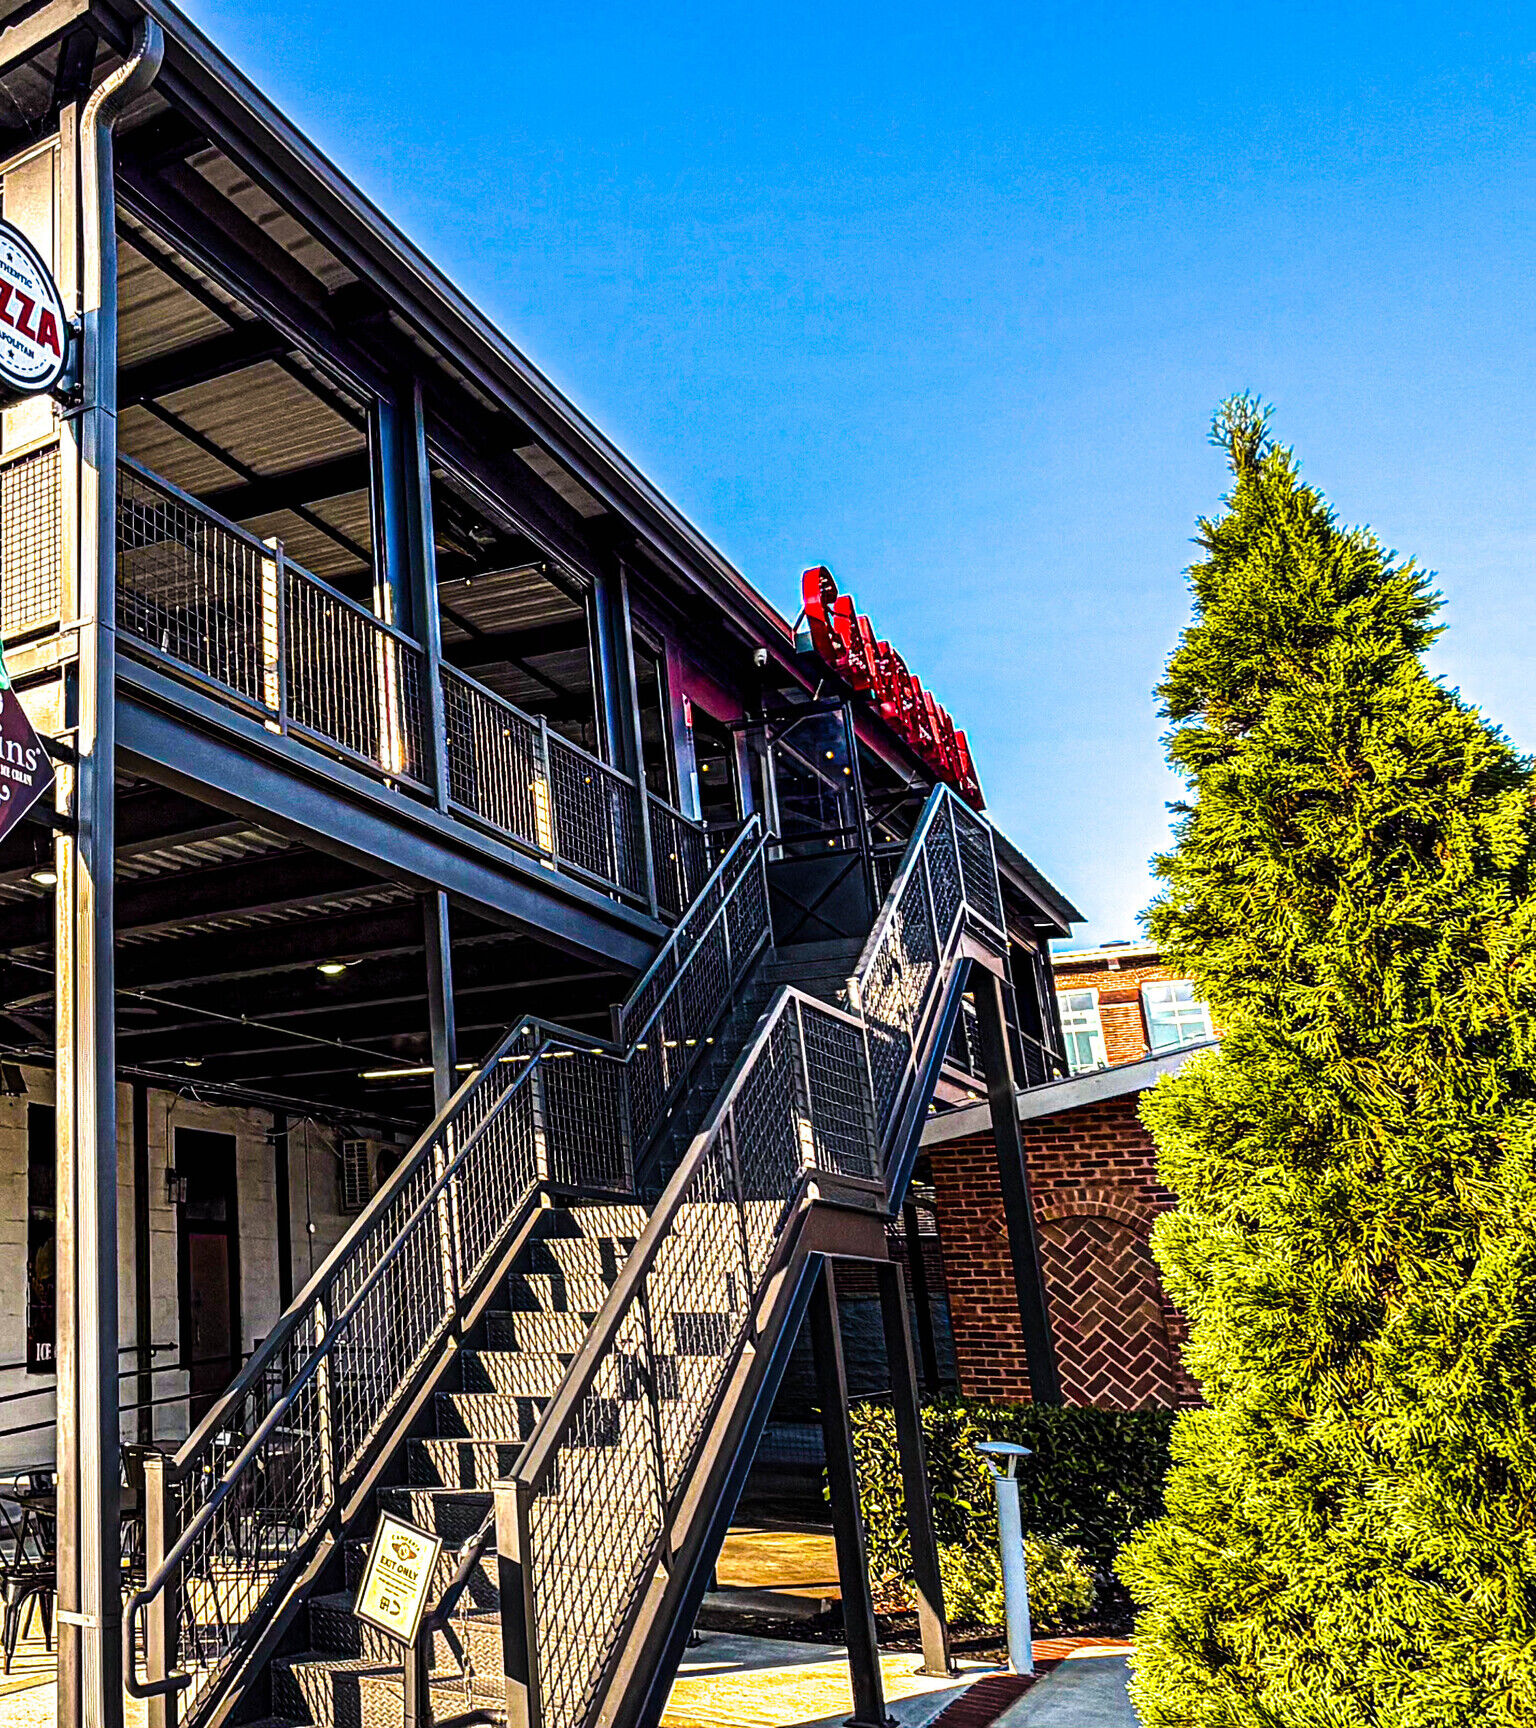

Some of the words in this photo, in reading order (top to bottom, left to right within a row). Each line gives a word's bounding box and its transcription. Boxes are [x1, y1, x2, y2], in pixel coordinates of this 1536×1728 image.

[36, 1342, 52, 1361] ICE
[380, 1555, 397, 1570] EXIT
[397, 1564, 419, 1581] ONLY
